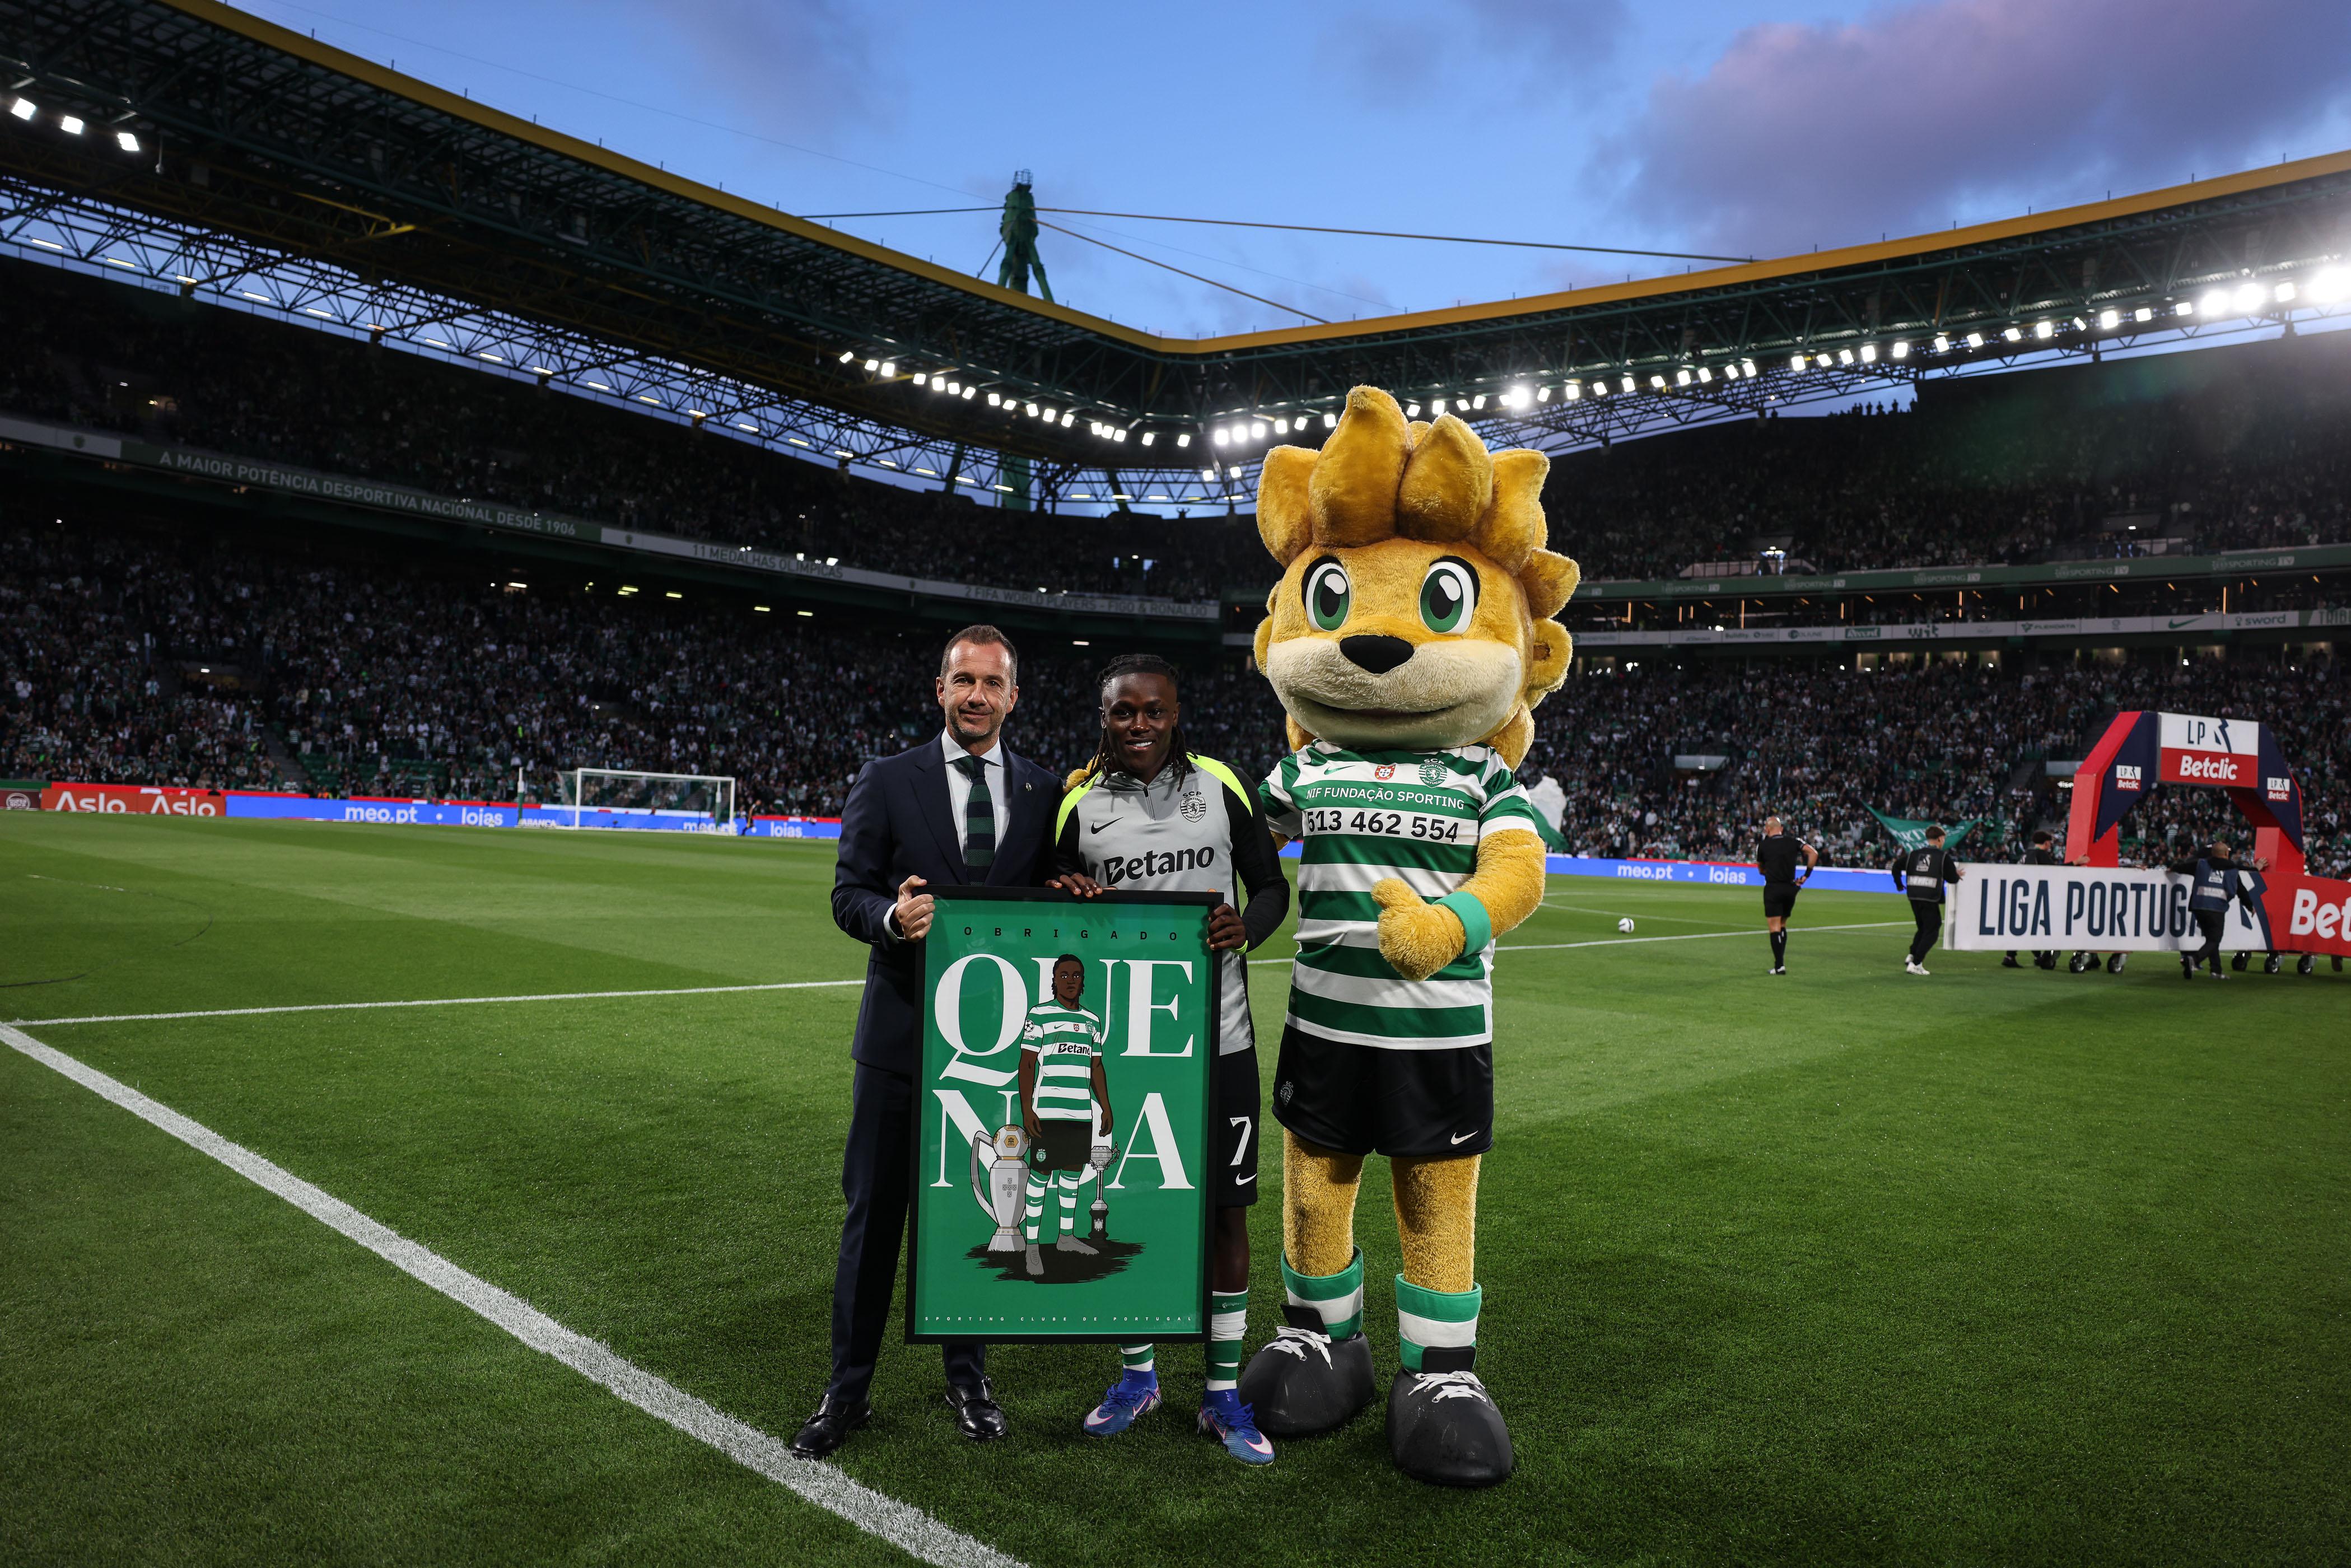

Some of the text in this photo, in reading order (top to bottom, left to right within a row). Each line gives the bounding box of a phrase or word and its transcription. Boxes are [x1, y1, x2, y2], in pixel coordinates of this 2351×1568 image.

[160, 451, 576, 536] A MAIOR POTÊNCIA DESPORTIVA NACIONAL DESDE 1906
[693, 544, 705, 556] 11
[710, 547, 775, 569] MEDALHAS
[976, 590, 999, 601] FIFA
[1004, 592, 1043, 605] WORLD
[1046, 595, 1097, 609] PLAYERS
[1109, 600, 1133, 612] FIGO
[1150, 603, 1207, 616] RONALDO
[2245, 614, 2286, 625] sword
[2187, 720, 2205, 745] LP
[1422, 764, 1445, 772] SPORTING
[2180, 755, 2238, 781] Betclic
[2117, 780, 2139, 790] Betclic
[2269, 791, 2288, 801] Betclic
[1306, 787, 1465, 810] NIF FUNDAÇÃO SPORTING
[345, 806, 418, 824] meo.pt
[1308, 810, 1459, 843] 513 462 554
[1103, 846, 1215, 886] Betano
[1617, 864, 1747, 884] meo.pt lojas
[1979, 879, 2203, 937] LIGA PORTUG
[964, 926, 1177, 941] OBRIGADO
[1229, 1116, 1252, 1165] 7
